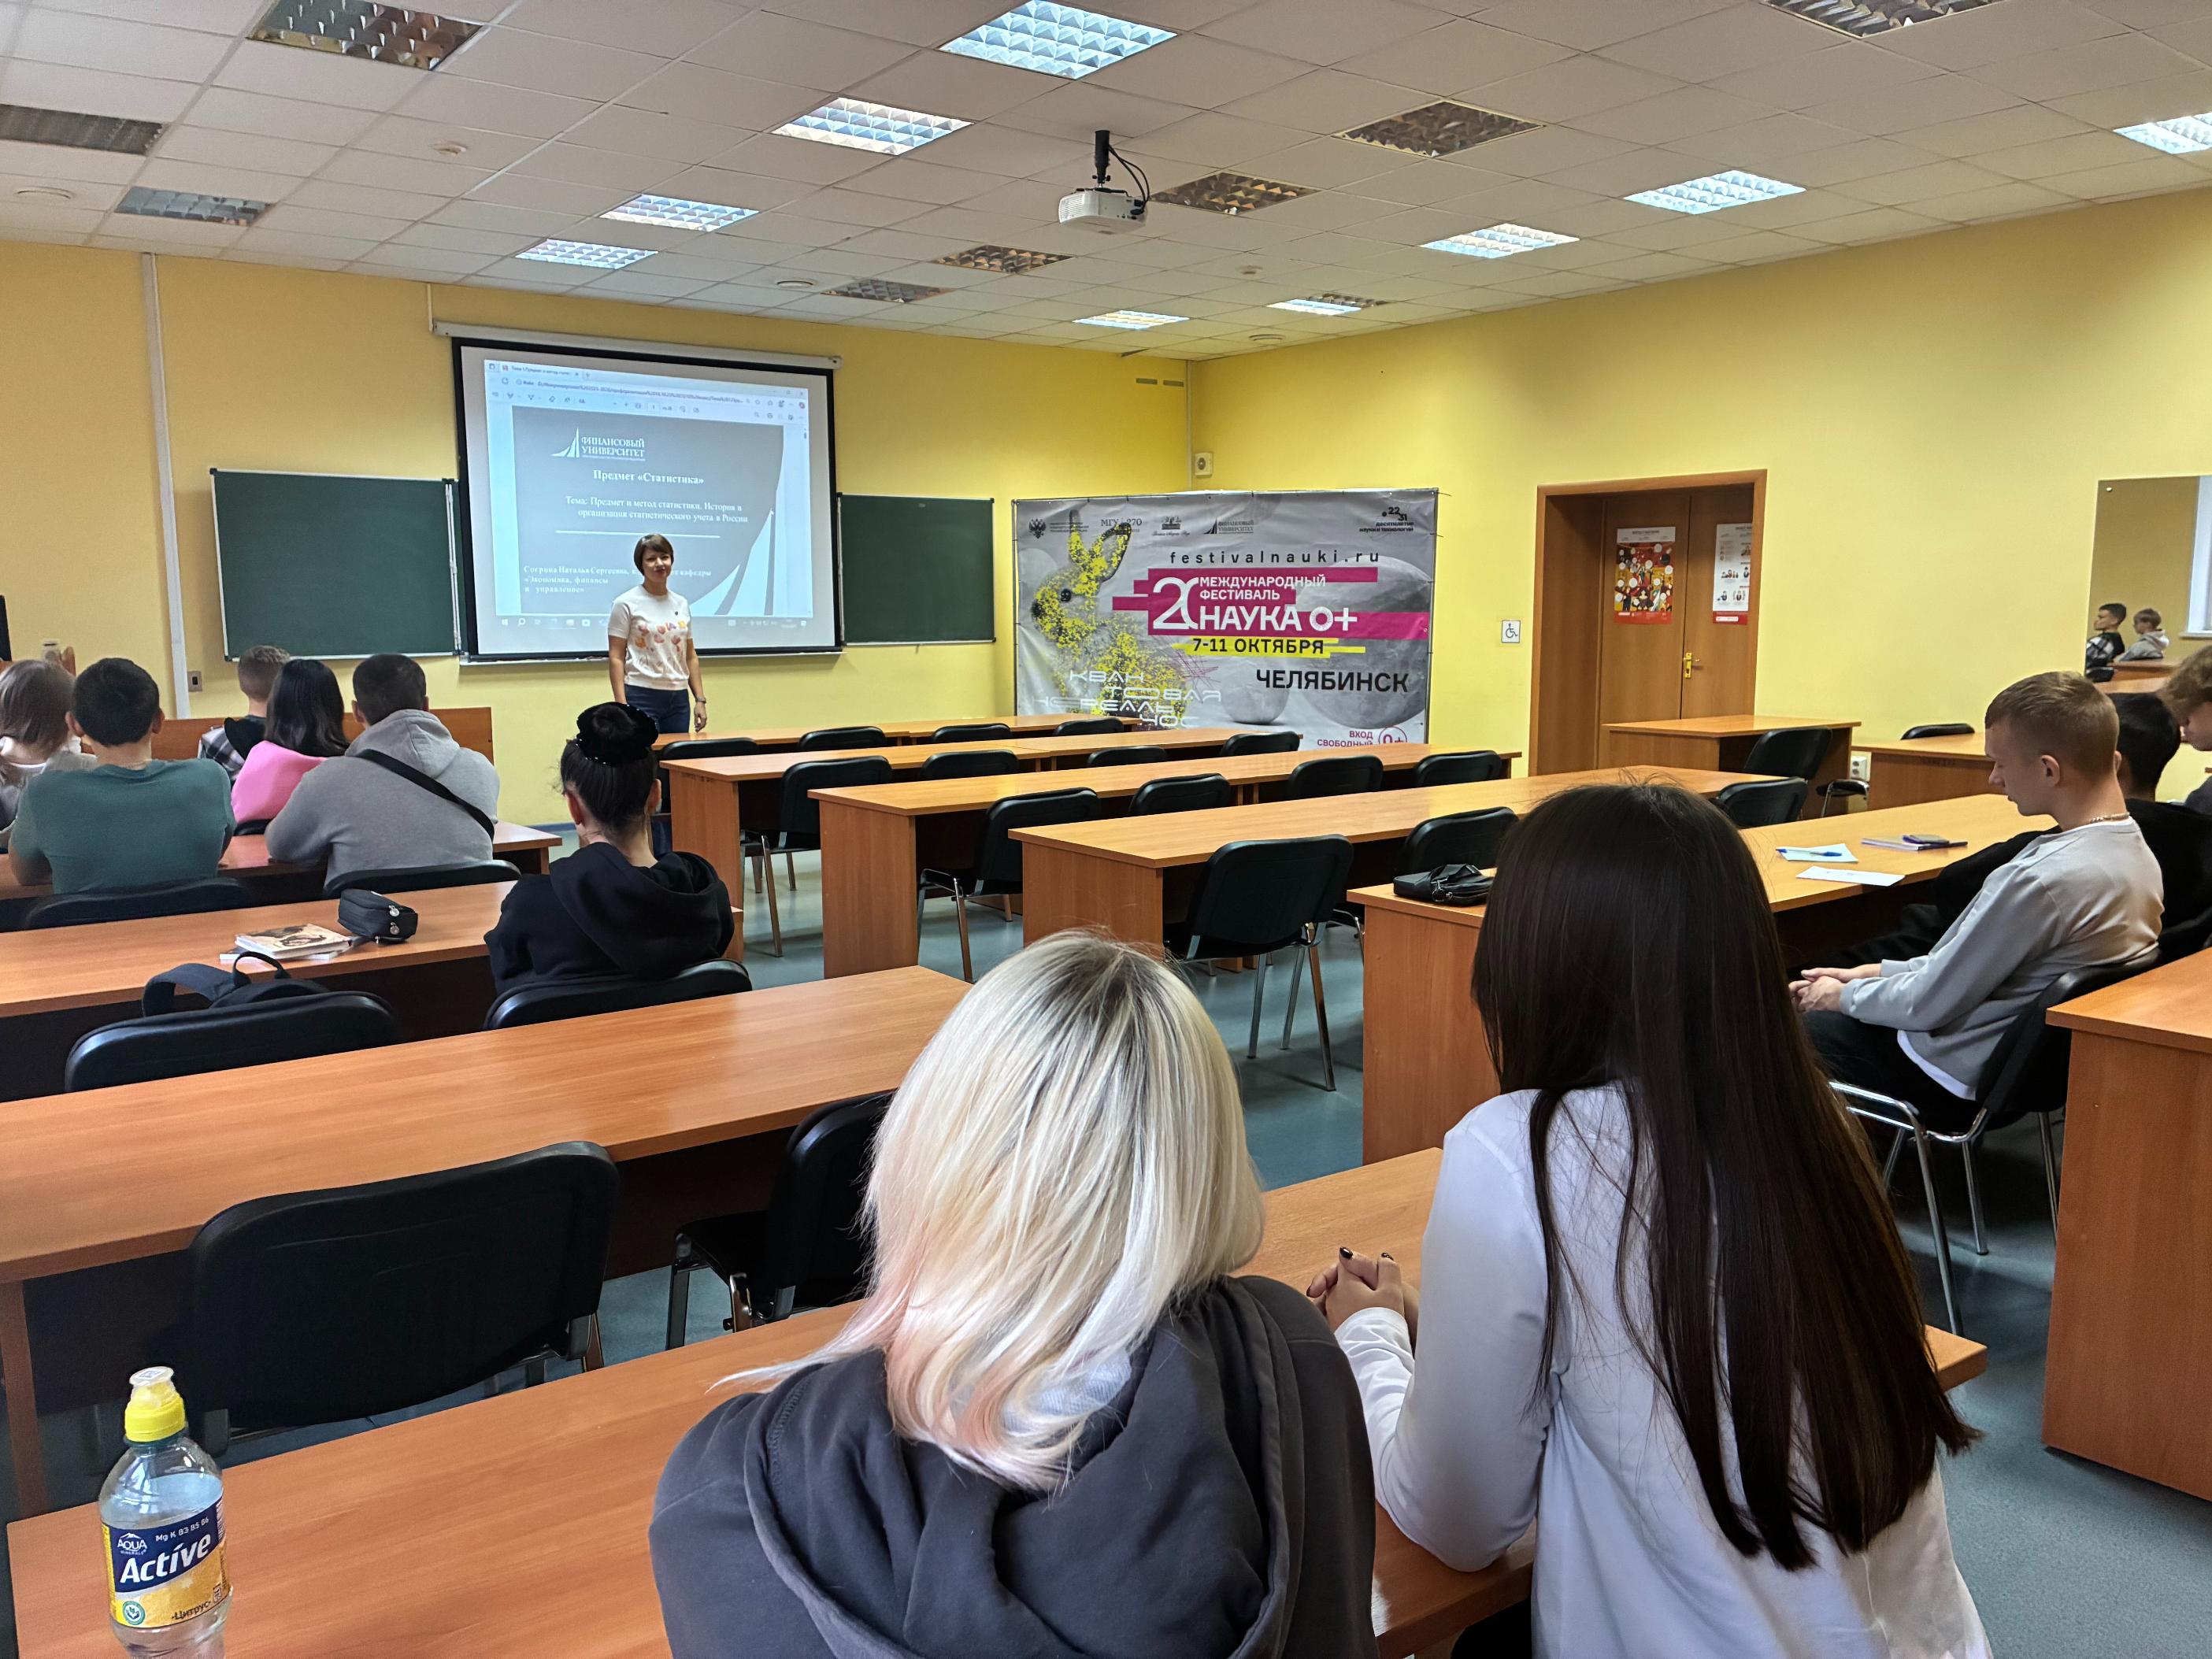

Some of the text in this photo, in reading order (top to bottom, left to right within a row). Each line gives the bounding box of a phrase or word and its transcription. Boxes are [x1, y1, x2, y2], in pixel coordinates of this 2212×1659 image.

[581, 436, 645, 448] ФИНАНСОВЫЙ
[581, 446, 645, 457] УНИВЕРСИТЕТ
[593, 470, 705, 484] Предмет «Статистика»
[565, 496, 587, 505] Тема:
[591, 497, 624, 508] Предмет
[634, 500, 656, 509] метод
[704, 502, 735, 512] История
[629, 513, 691, 521] статистического
[722, 514, 748, 523] России
[1170, 550, 1379, 564] festivalnauki.ru
[1199, 574, 1326, 587] МЕЖДУНАРОДНЫЙ
[1199, 589, 1280, 601] ФЕСТИВАЛЬ
[1199, 605, 1302, 631] НАУКА
[1193, 638, 1325, 654] 7-11 ОКТЯБРЯ
[1256, 668, 1409, 693] ЧЕЛЯБИНСК
[1349, 731, 1373, 740] ВХОД
[117, 1539, 148, 1551] AQUA
